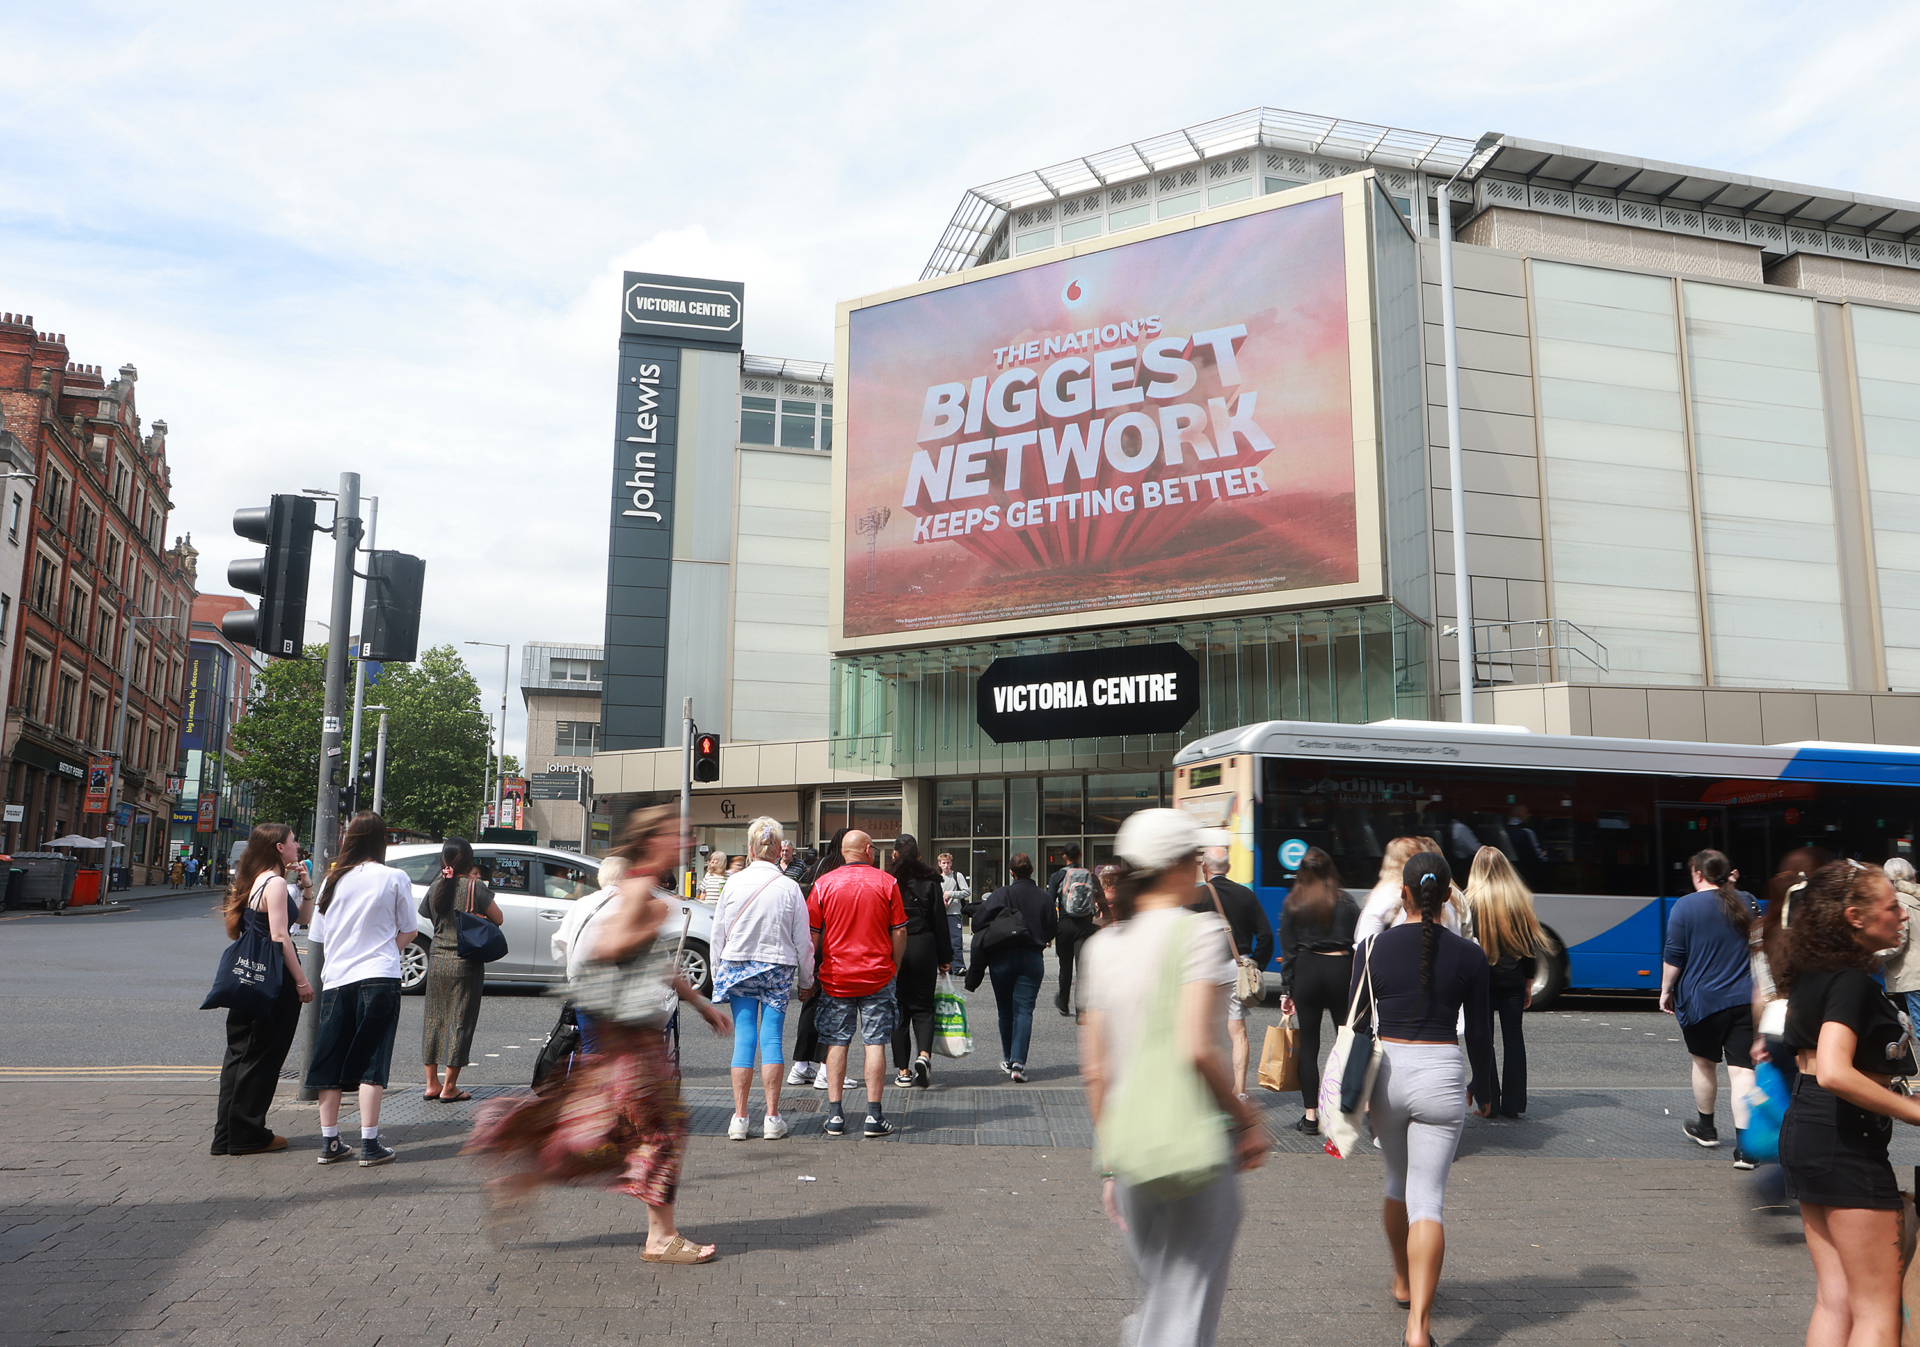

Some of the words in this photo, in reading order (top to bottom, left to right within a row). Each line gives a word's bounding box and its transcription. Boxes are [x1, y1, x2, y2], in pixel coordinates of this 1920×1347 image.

[636, 296, 687, 314] VICTORIA
[688, 301, 731, 318] CENTRE
[992, 340, 1041, 369] THE
[1043, 315, 1163, 358] NATION'S
[916, 323, 1248, 445] BIGGEST
[625, 364, 661, 443] Lewis
[902, 391, 1276, 508] NETWORK
[621, 451, 663, 523] John
[912, 505, 1001, 543] KEEPS
[1006, 485, 1136, 528] GETTING
[1141, 466, 1270, 510] BETTER
[286, 642, 291, 651] B
[365, 645, 369, 654] E
[190, 660, 199, 688] discounts
[189, 689, 198, 698] big
[993, 680, 1088, 714] VICTORIA
[1092, 672, 1177, 706] CENTRE
[186, 722, 194, 733] big
[1298, 740, 1331, 749] Carlton
[1335, 742, 1361, 752] Valley
[1440, 747, 1460, 758] City
[546, 762, 569, 774] John
[936, 1000, 962, 1015] SDA
